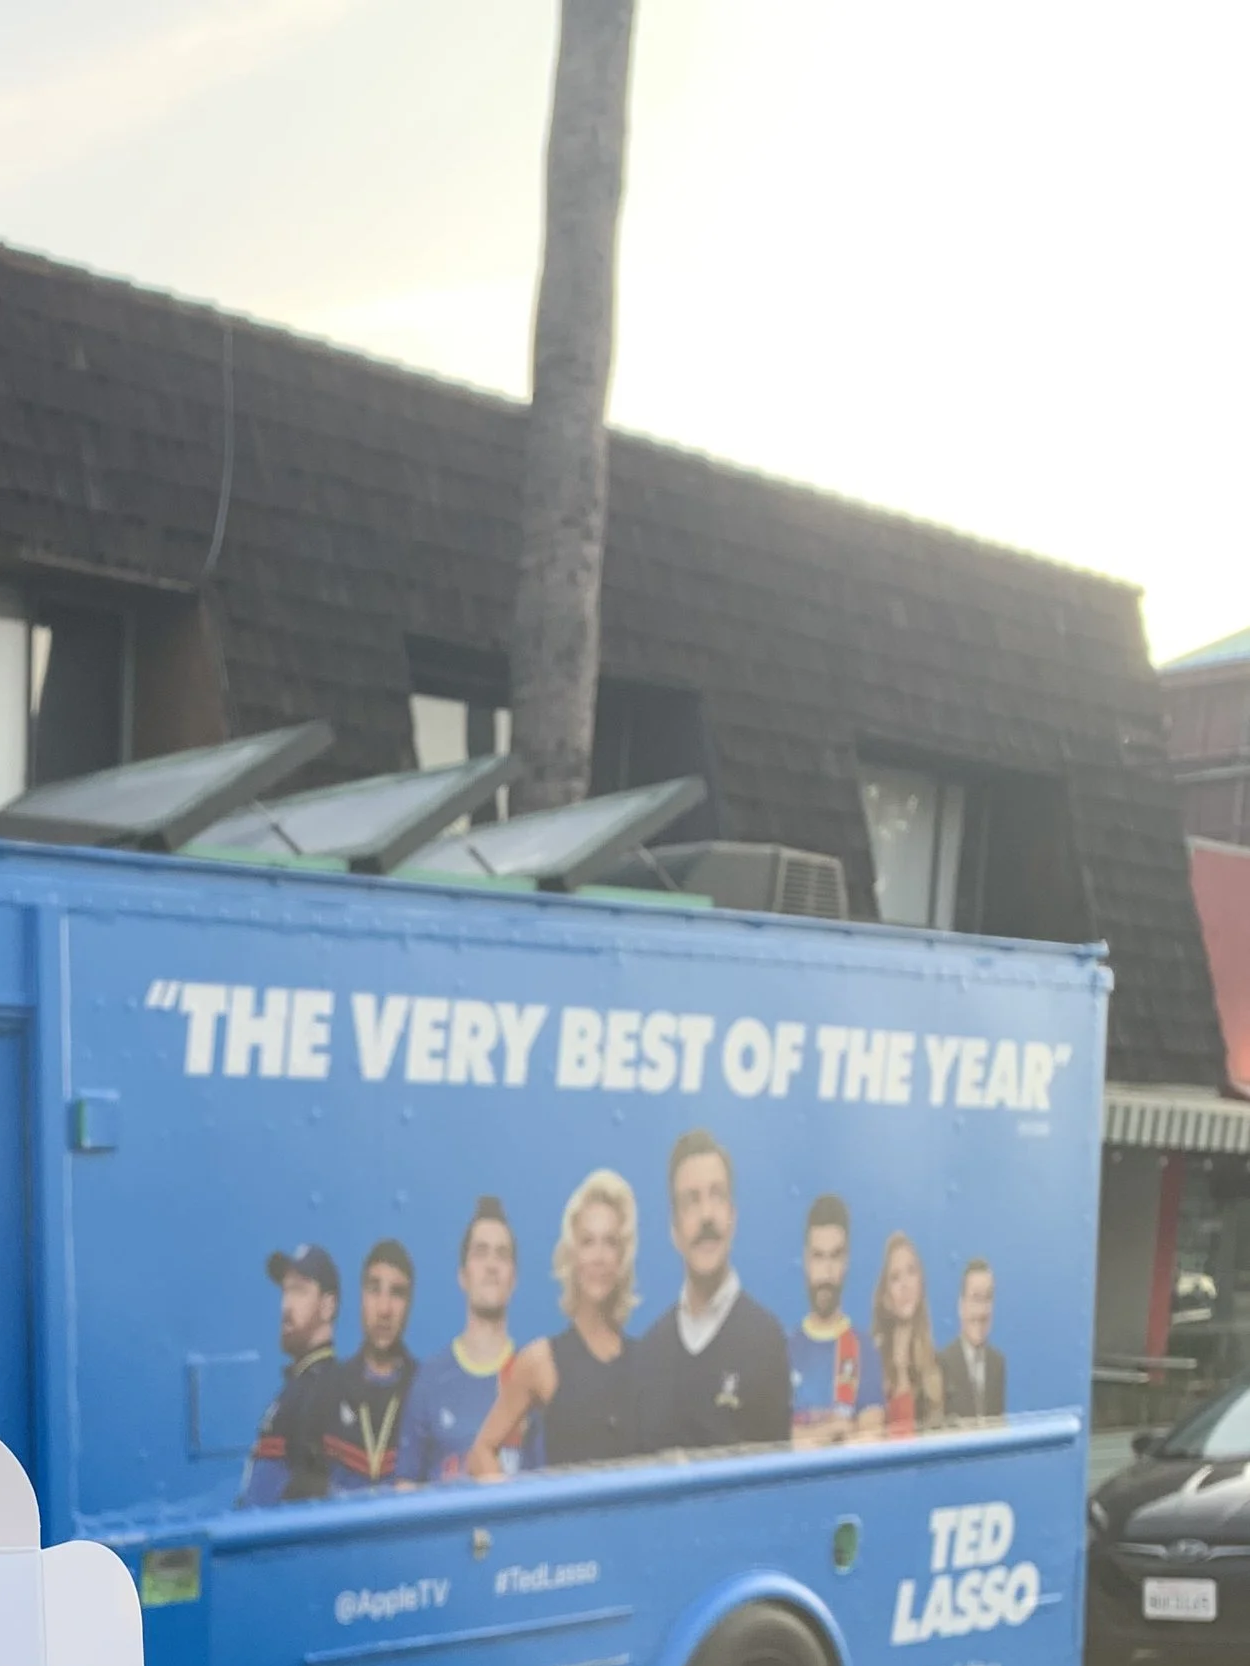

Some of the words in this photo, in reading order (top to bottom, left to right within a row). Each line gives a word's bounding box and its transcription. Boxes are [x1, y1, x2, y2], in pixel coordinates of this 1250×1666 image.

[352, 992, 547, 1086] VERY
[556, 1009, 715, 1093] BEST
[721, 1018, 805, 1098] OF
[816, 1026, 914, 1103] THE
[930, 1503, 1013, 1570] TED
[335, 1578, 449, 1625] @AppleTV
[497, 1561, 598, 1595] #TedLasso
[891, 1561, 1040, 1646] LASSO
